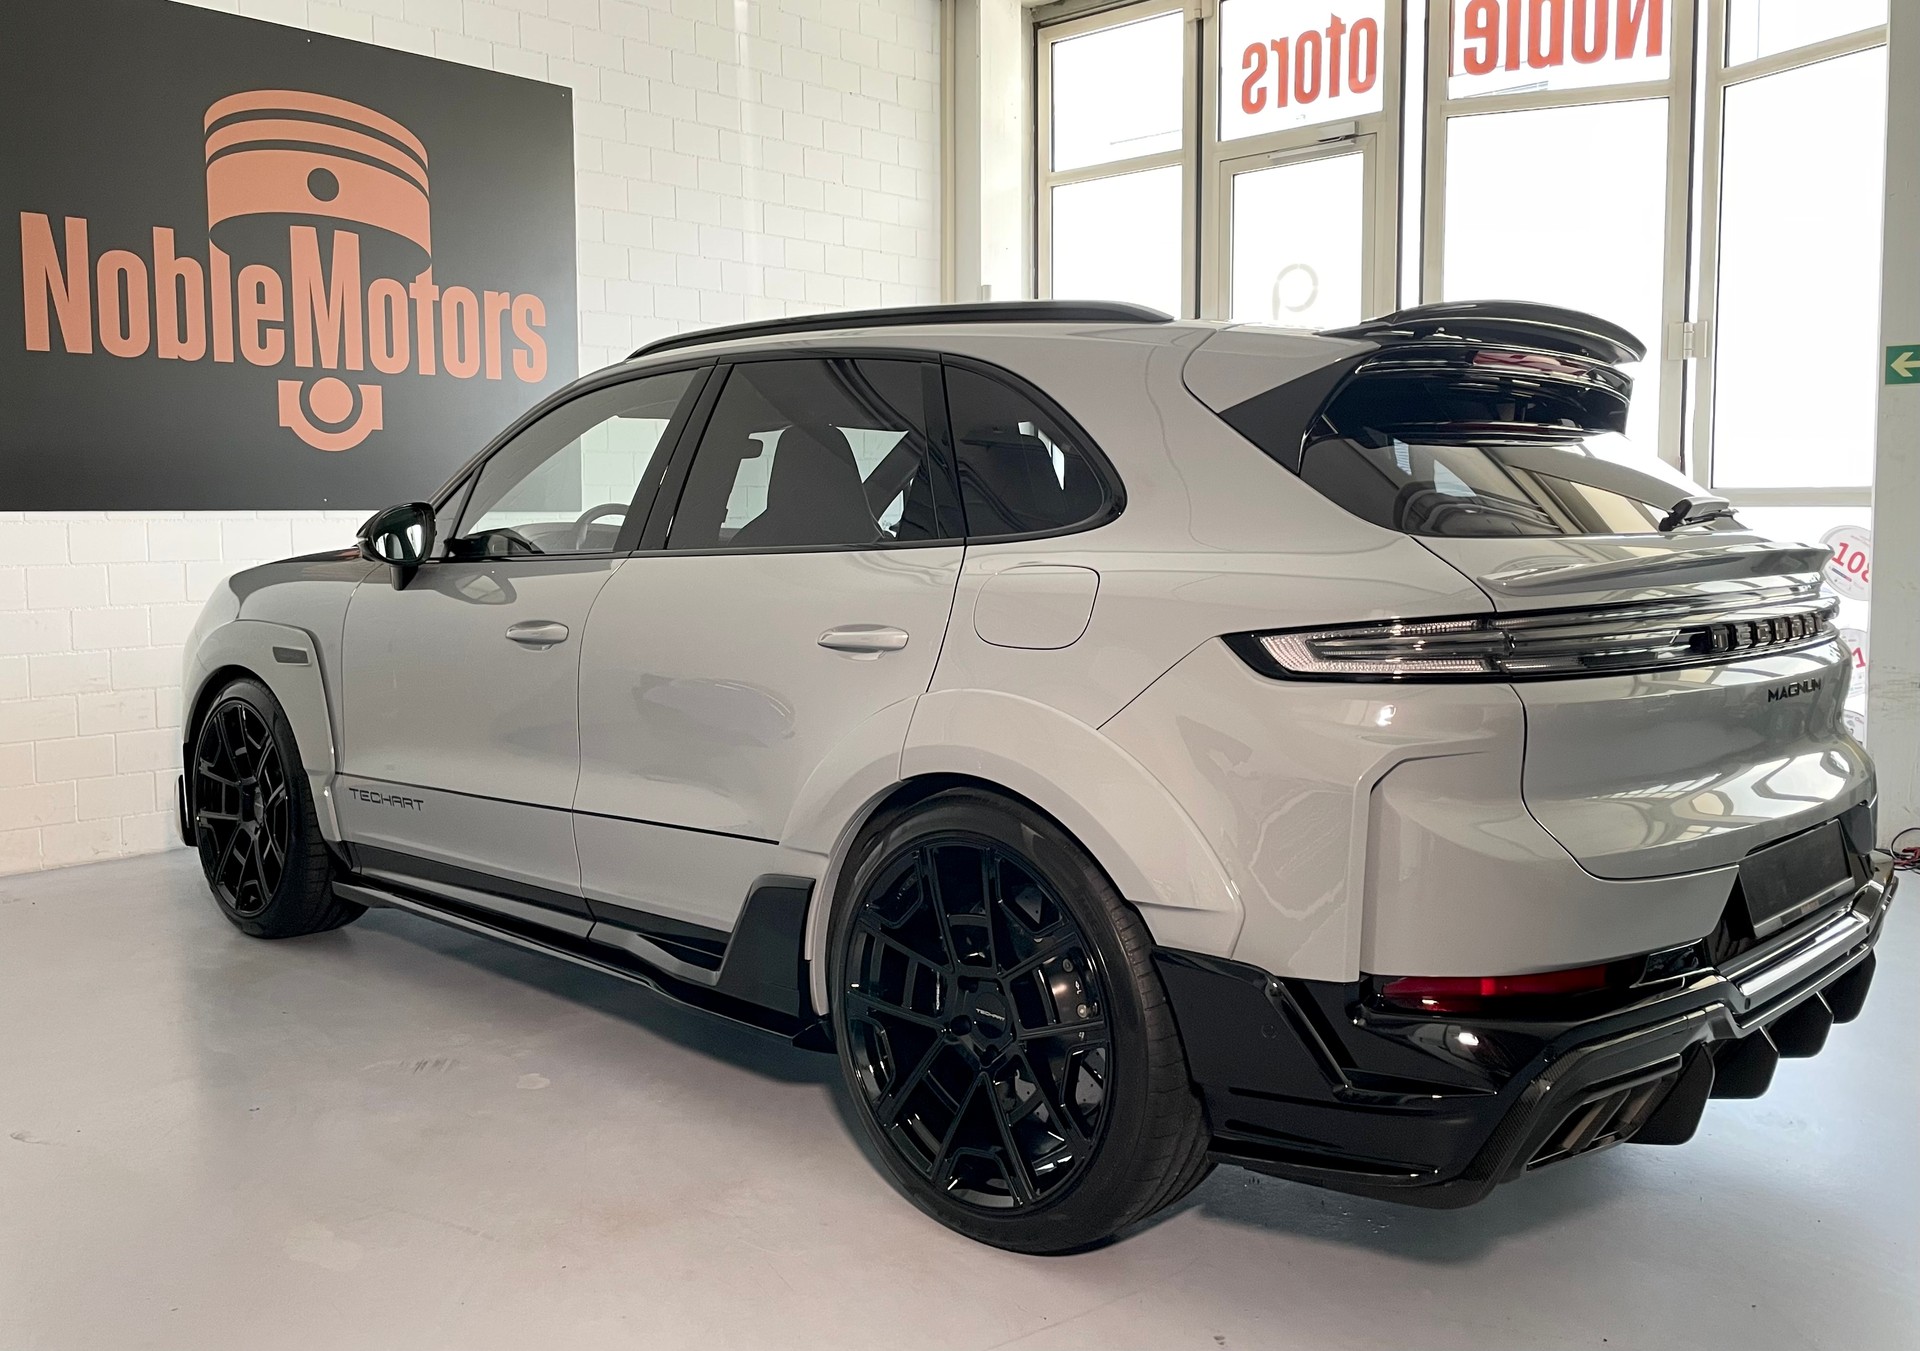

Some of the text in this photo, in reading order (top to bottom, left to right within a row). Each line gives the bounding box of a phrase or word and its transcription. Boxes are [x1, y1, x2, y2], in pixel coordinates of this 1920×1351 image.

[20, 211, 548, 384] NobleMotors
[1768, 677, 1821, 702] MAGNUM
[348, 787, 424, 811] TECHART
